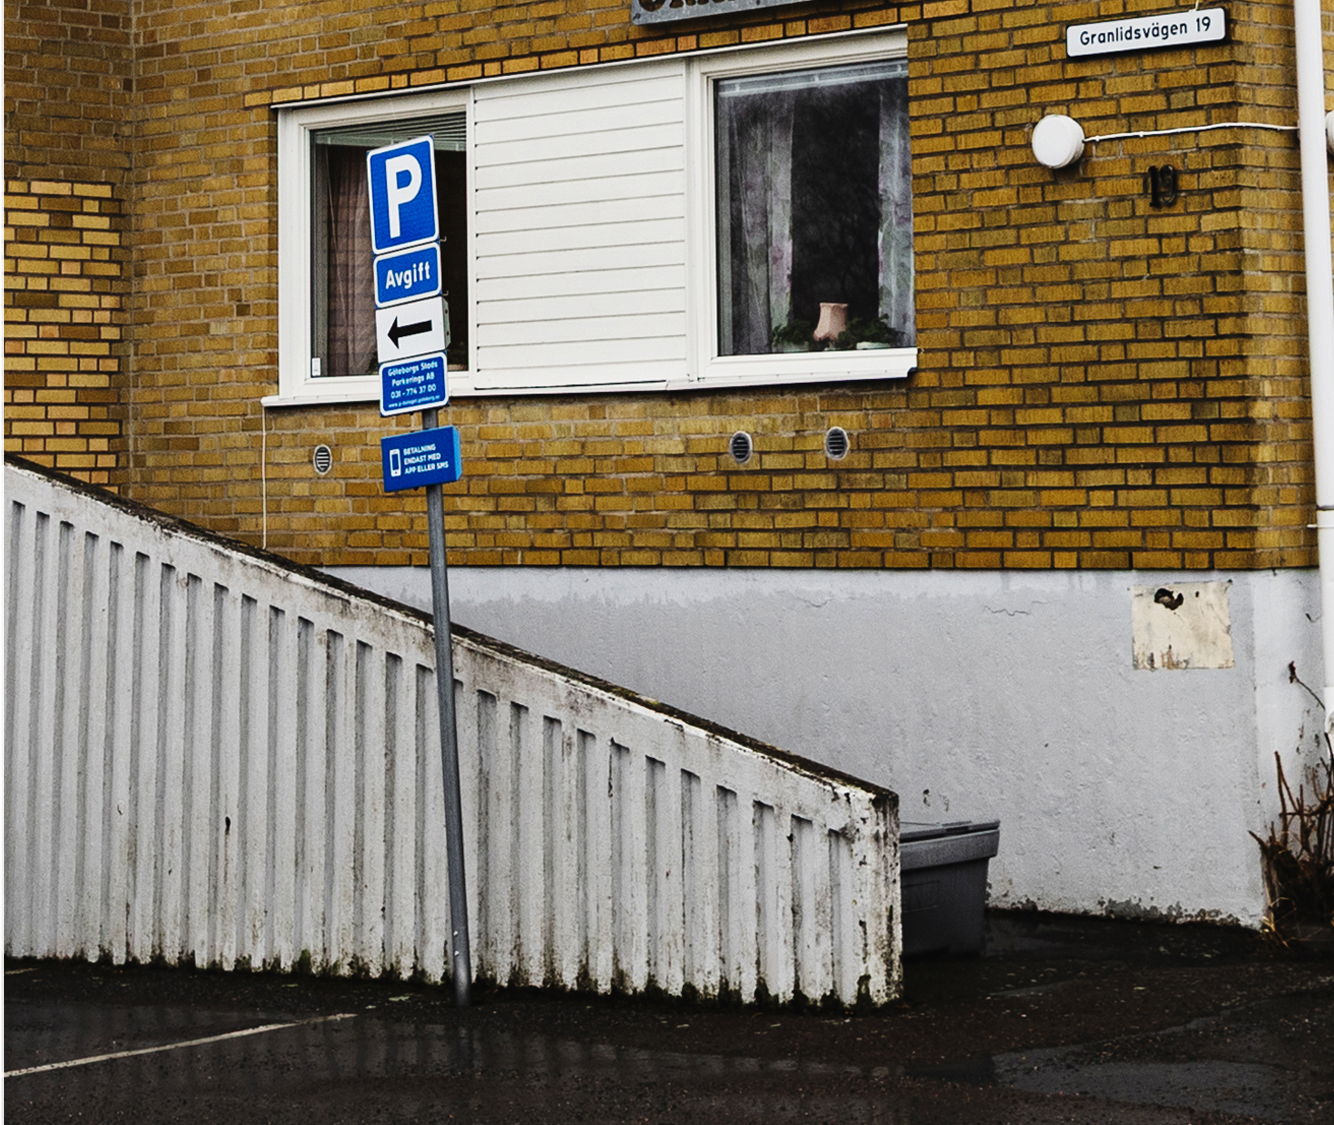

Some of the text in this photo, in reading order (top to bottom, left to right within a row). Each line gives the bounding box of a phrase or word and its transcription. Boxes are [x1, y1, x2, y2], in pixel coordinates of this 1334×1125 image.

[1080, 16, 1211, 46] Granlidsvägen 19
[385, 154, 423, 239] P
[385, 261, 431, 290] Avgift
[388, 361, 438, 376] Göteborgs Stads
[426, 371, 435, 380] AB
[427, 383, 437, 392] 00
[403, 443, 436, 455] BETALNING
[404, 452, 441, 465] ENDAST MED
[404, 460, 449, 474] APP ELLER SMS
